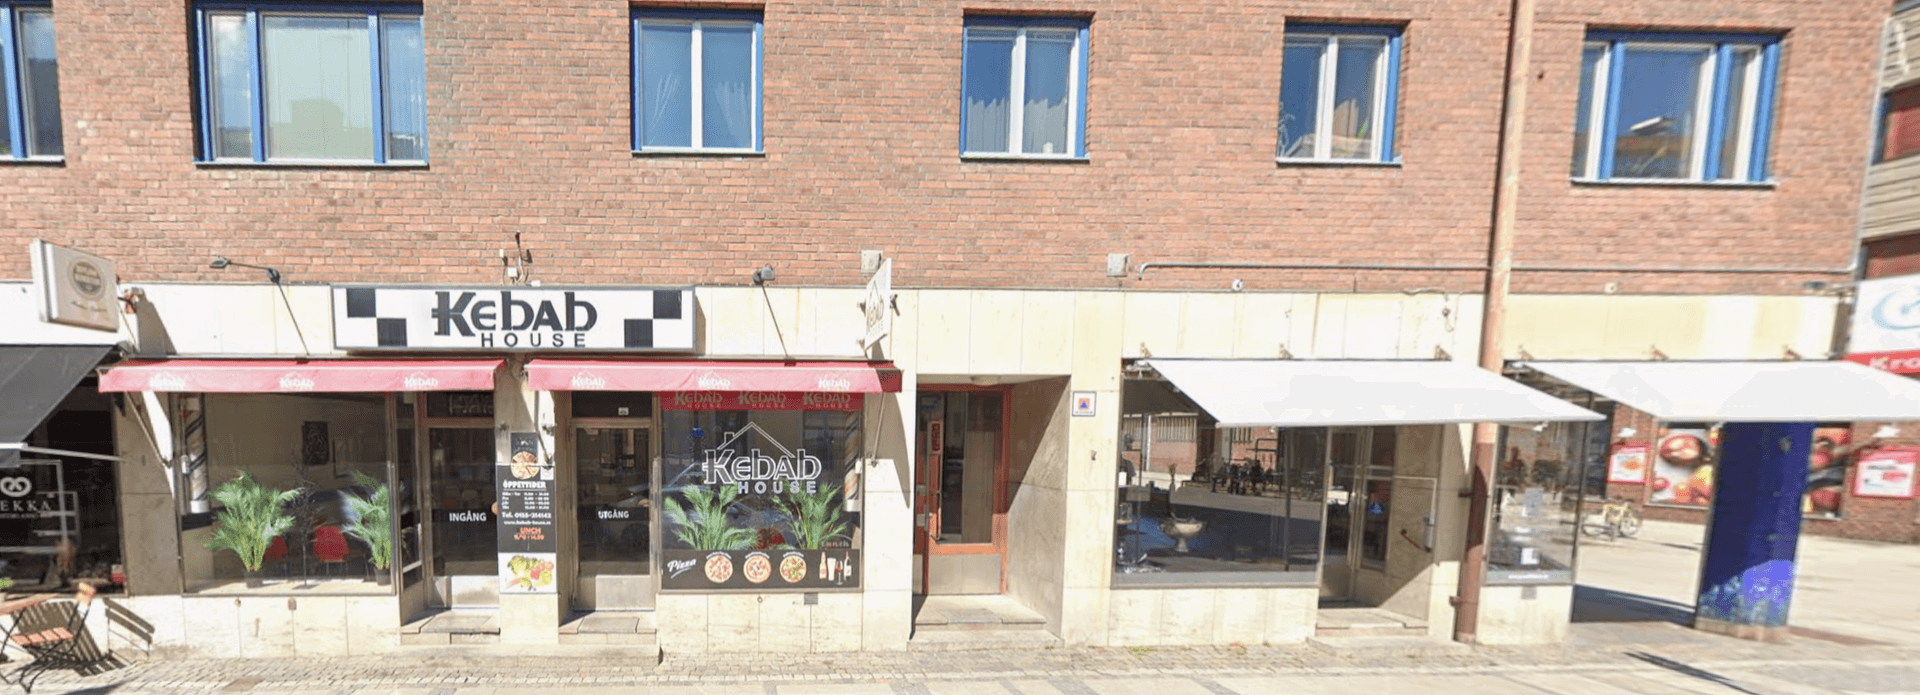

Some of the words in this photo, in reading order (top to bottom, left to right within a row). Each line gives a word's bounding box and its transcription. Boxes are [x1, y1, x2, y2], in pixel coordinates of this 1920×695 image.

[481, 332, 586, 348] HOUSE
[502, 479, 547, 489] ÖPPETTIDER
[737, 480, 817, 495] HOUSE
[449, 509, 487, 522] INGÅNG
[501, 511, 513, 519] Tel.
[597, 508, 630, 520] UTGÅNG
[667, 559, 697, 572] Pizza
